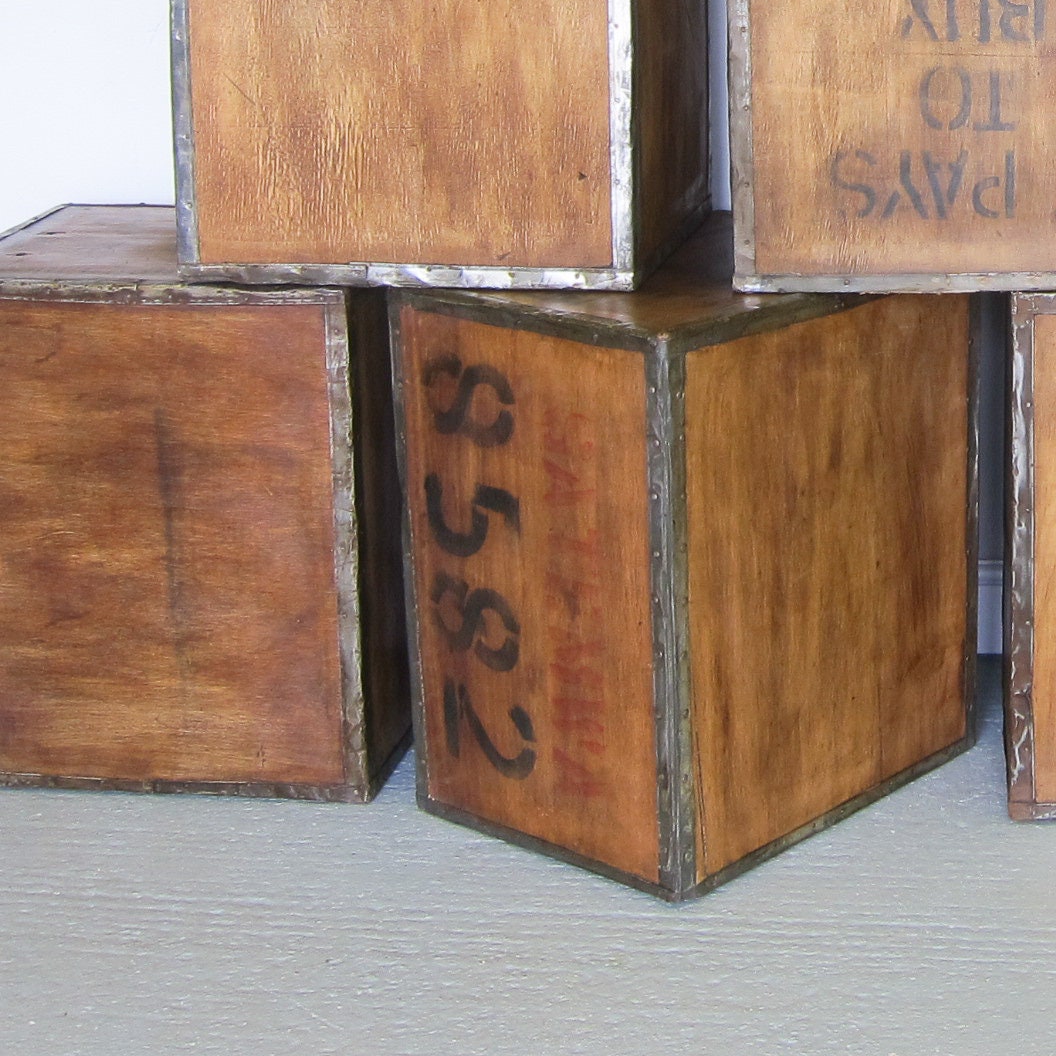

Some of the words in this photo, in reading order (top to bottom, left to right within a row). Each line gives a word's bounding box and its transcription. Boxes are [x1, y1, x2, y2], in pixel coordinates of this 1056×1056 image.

[918, 65, 1016, 132] TO
[830, 148, 1016, 220] PAYS
[421, 352, 537, 782] 8582
